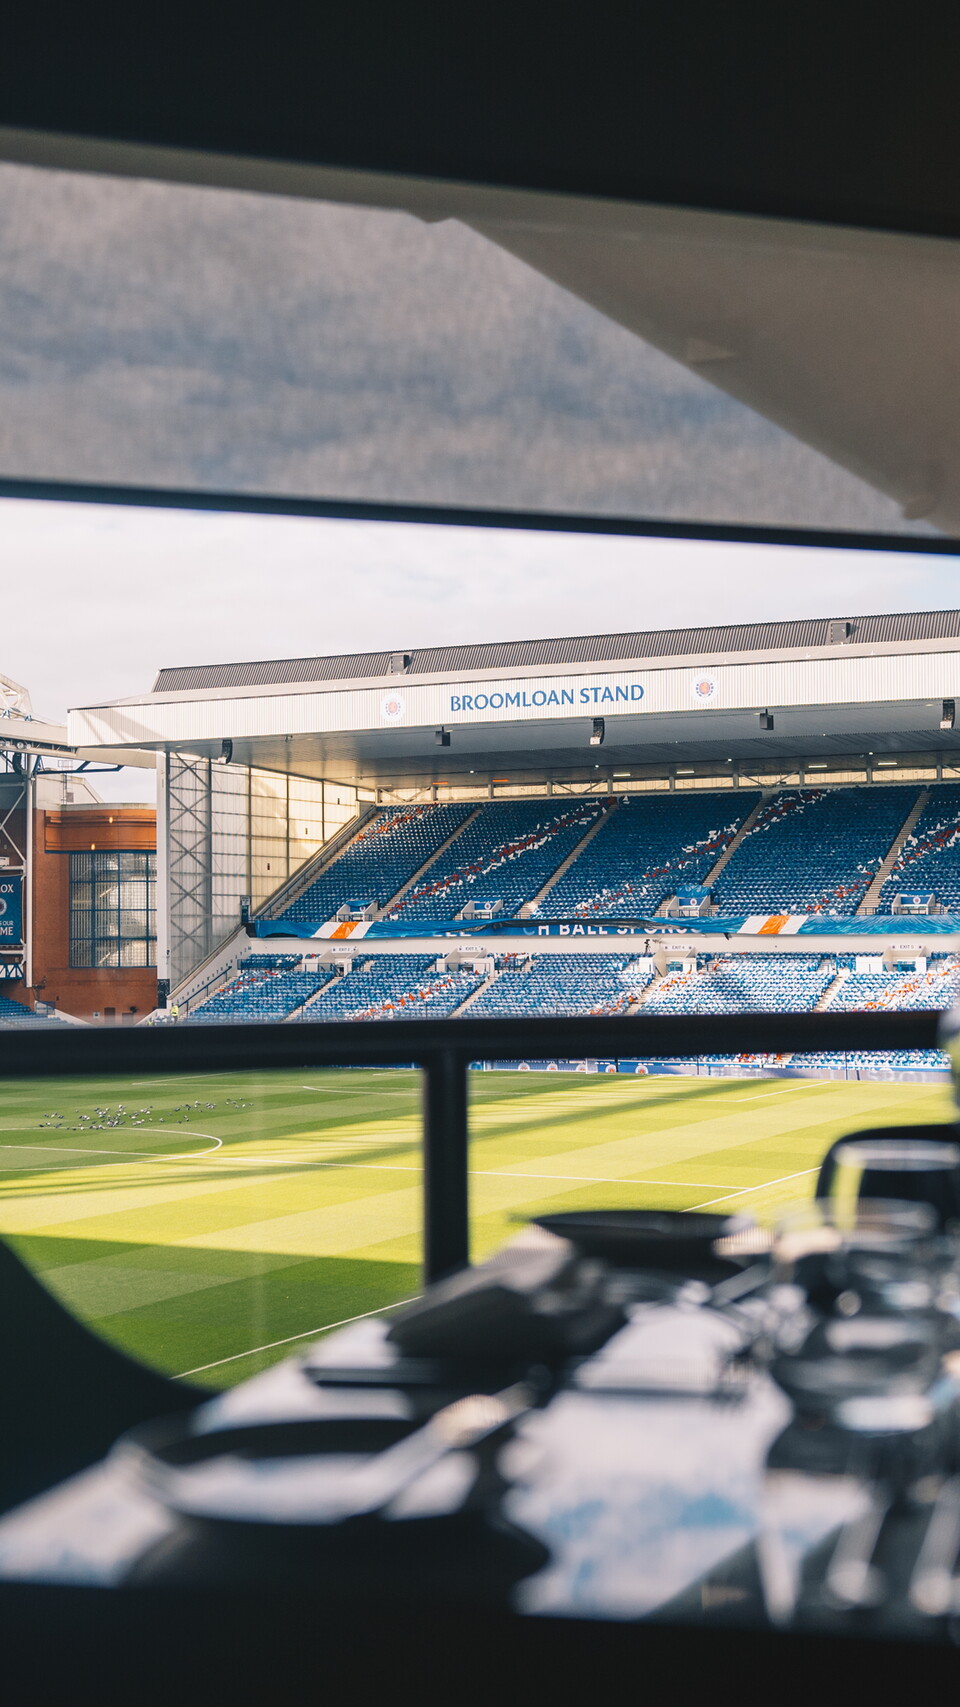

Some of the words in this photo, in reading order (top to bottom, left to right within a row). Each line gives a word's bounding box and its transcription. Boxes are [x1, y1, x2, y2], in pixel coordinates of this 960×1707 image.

[451, 689, 574, 711] BROOMLOAN
[580, 684, 644, 704] STAND
[559, 925, 608, 936] BALL
